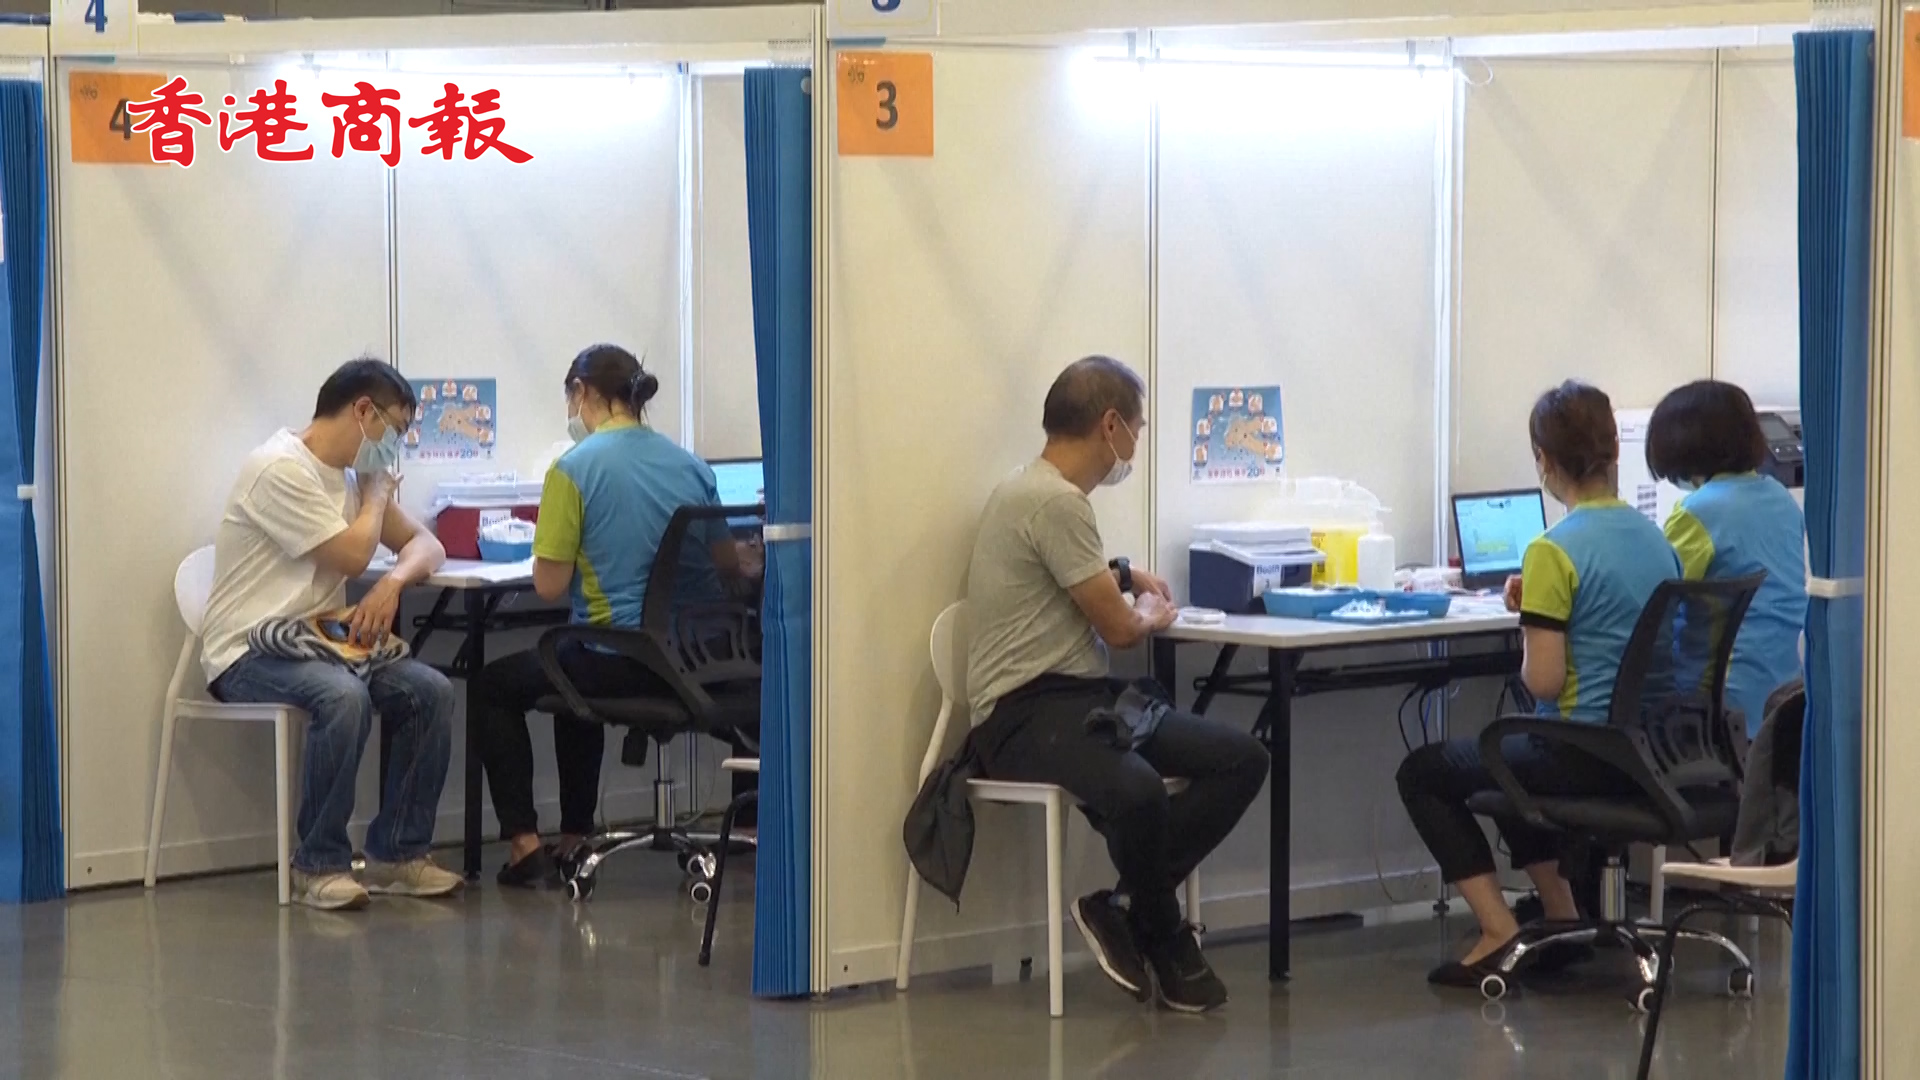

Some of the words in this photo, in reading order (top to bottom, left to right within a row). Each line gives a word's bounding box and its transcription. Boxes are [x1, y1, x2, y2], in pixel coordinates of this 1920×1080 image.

[85, 0, 108, 32] 4
[109, 98, 132, 140] 4
[876, 80, 898, 129] 3
